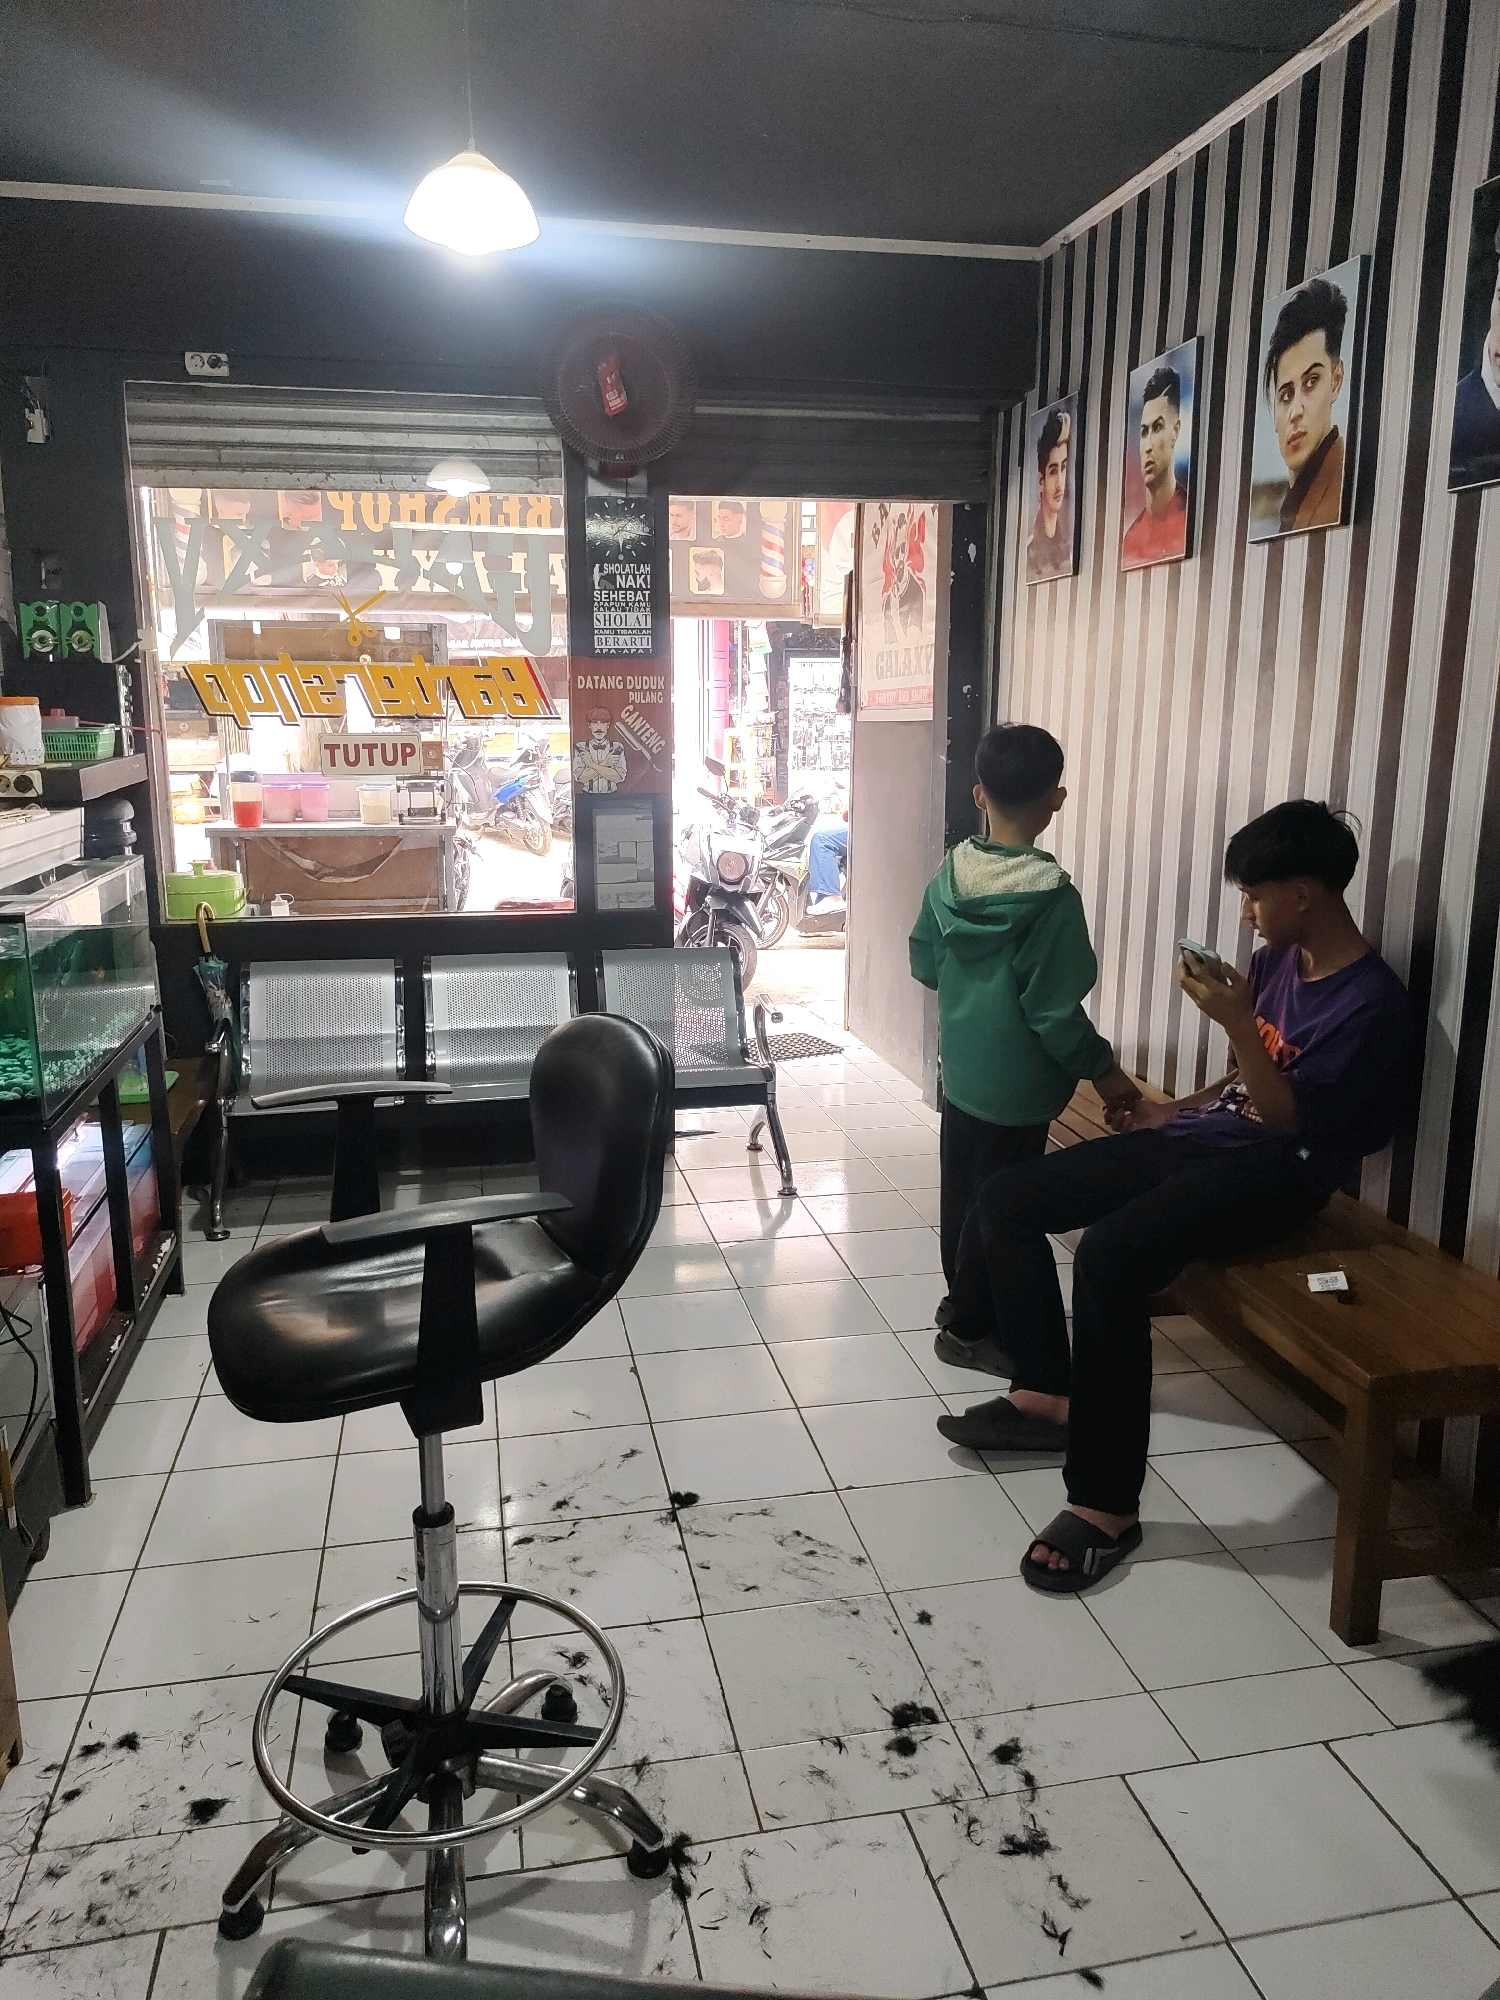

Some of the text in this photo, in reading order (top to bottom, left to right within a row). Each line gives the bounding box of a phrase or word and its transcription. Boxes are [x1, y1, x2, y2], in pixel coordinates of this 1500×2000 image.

[603, 563, 651, 575] SHOLATLAH
[616, 575, 651, 589] NAK!
[593, 590, 651, 602] SEHEBAT
[595, 613, 651, 627] SHOLAT
[596, 636, 651, 647] BERARTI
[875, 643, 935, 681] GALAXY
[577, 675, 665, 690] DATANG DUDUK
[628, 691, 664, 704] PULANG
[620, 704, 666, 755] GANTENG
[323, 743, 418, 768] TUTUP
